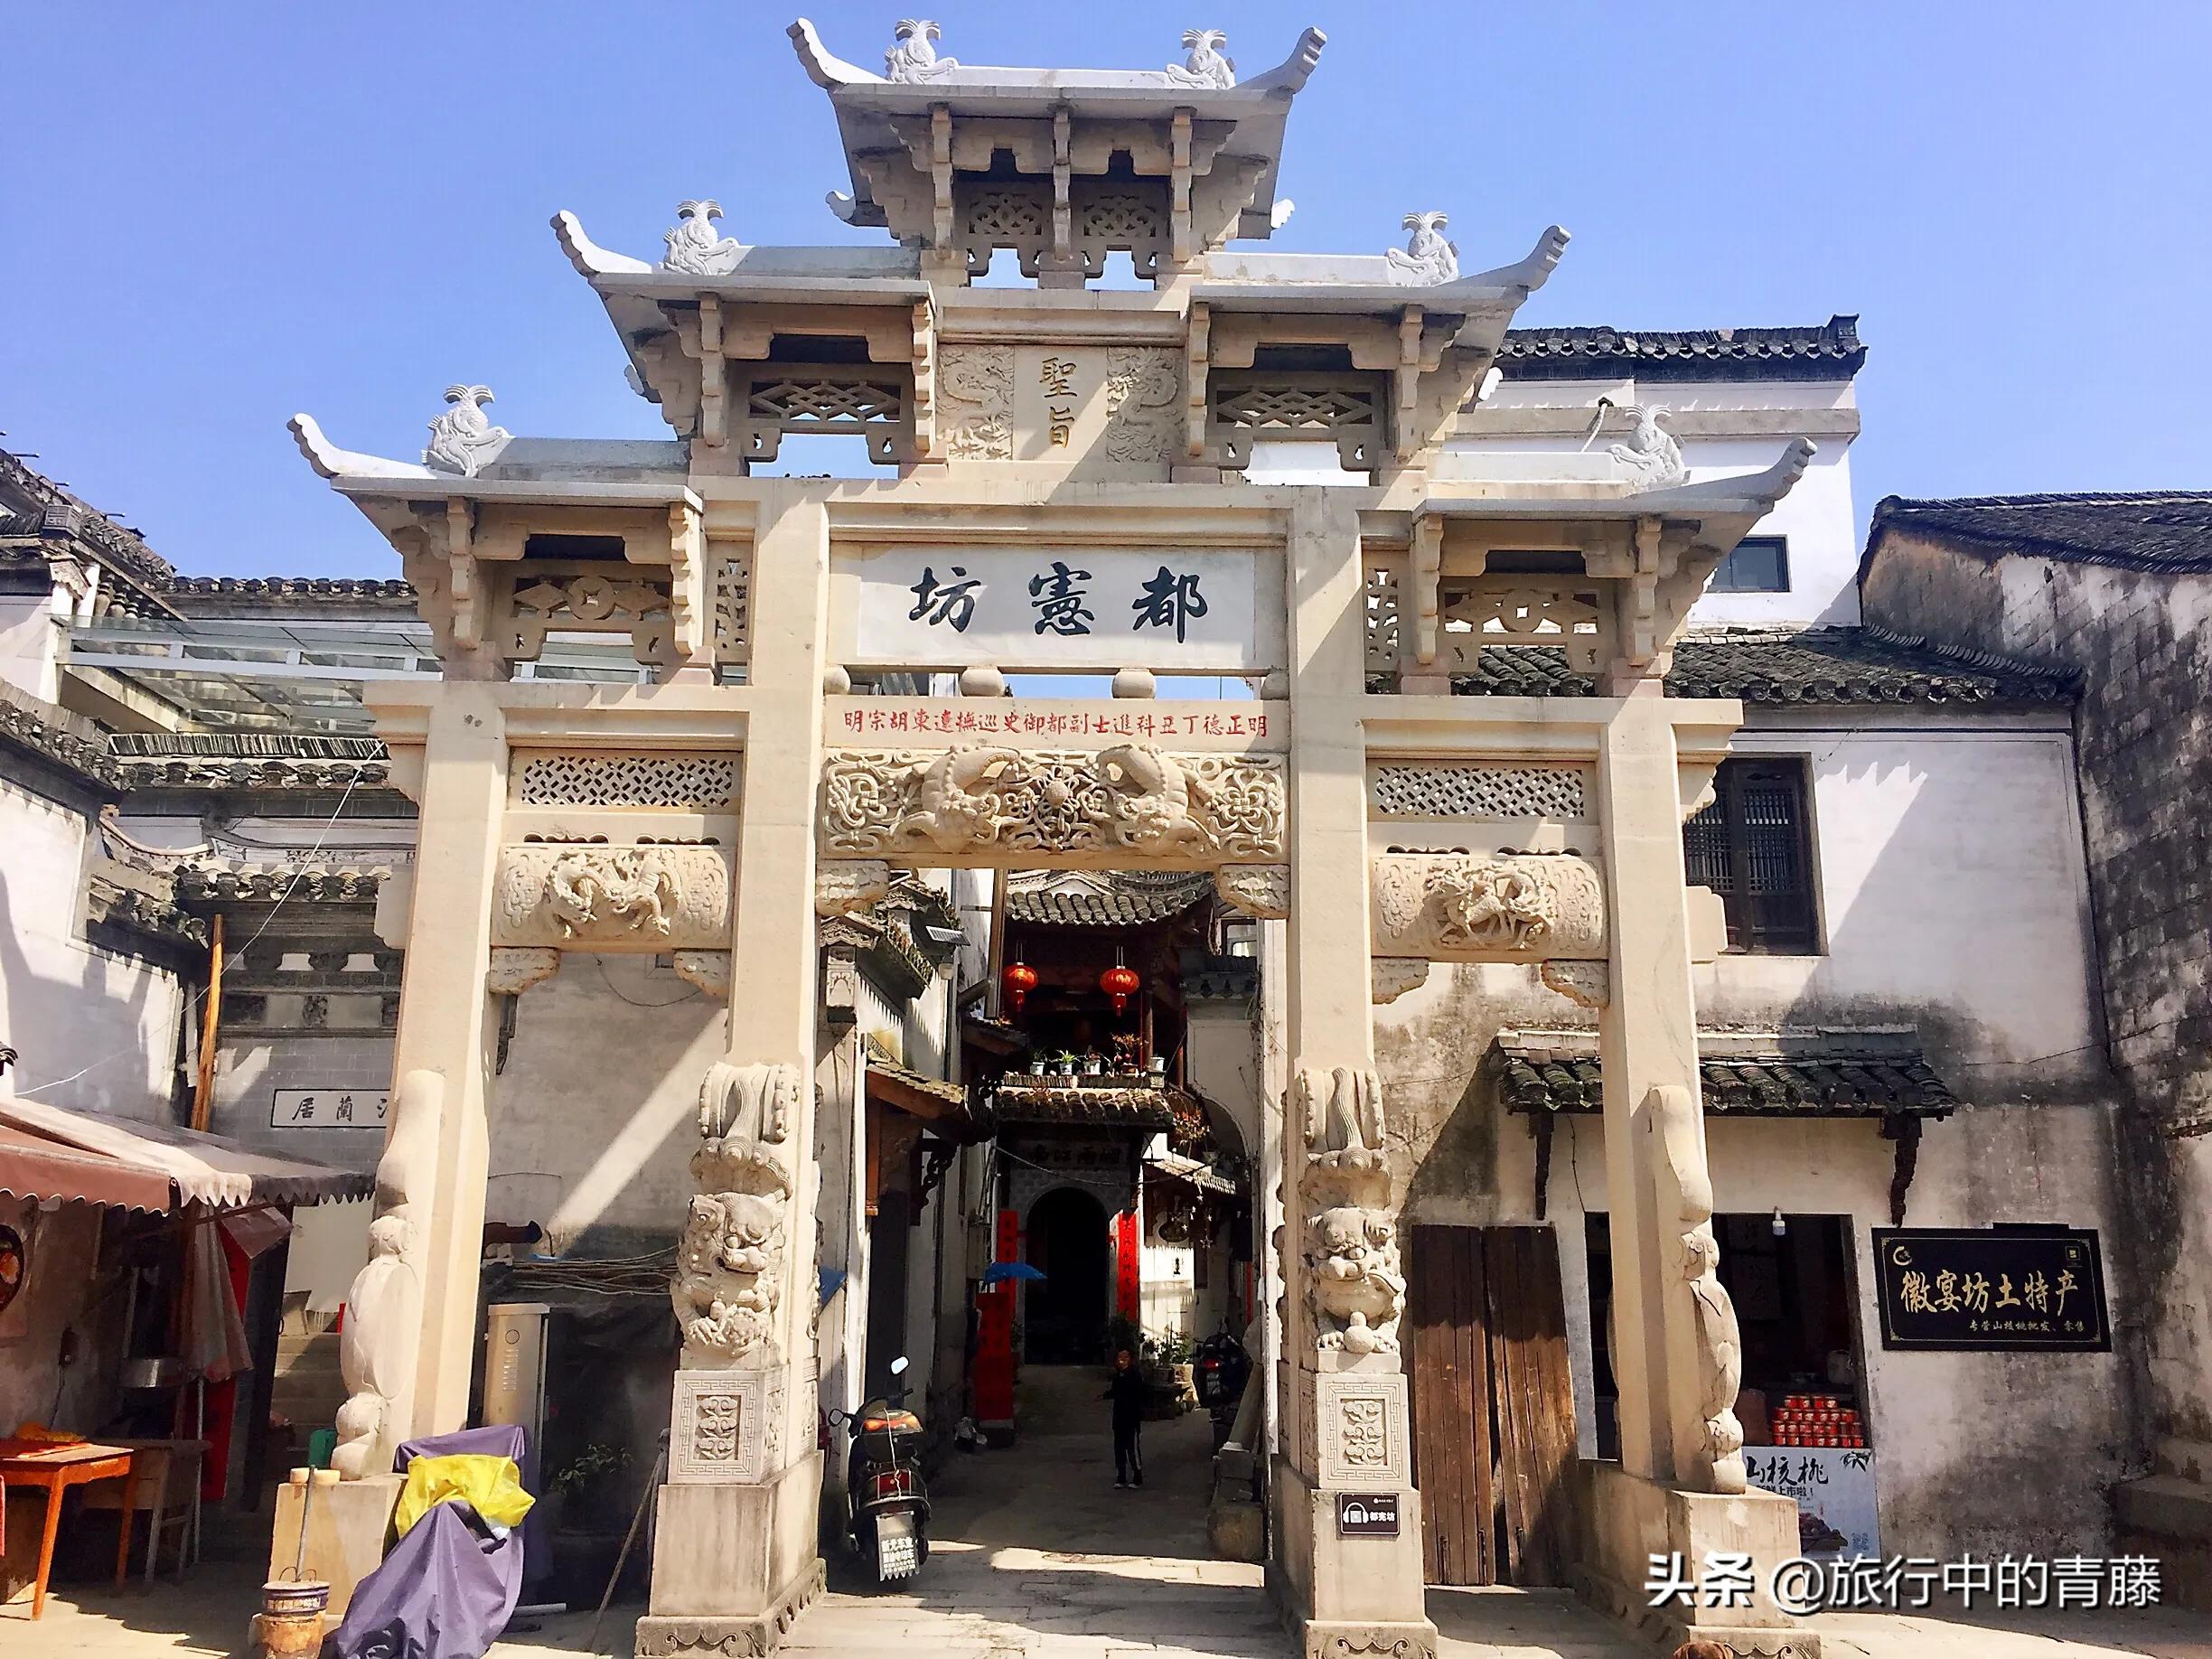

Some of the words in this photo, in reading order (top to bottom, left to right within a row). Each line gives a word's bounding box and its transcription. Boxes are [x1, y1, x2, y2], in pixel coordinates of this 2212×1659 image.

[1038, 356, 1078, 449] 聖旨
[908, 560, 1209, 644] 都憲坊
[1900, 1269, 2079, 1317] 徽宴坊土特产
[1746, 1455, 1830, 1486] 山核桃
[1756, 1485, 1814, 1497] 鲜上市啦！
